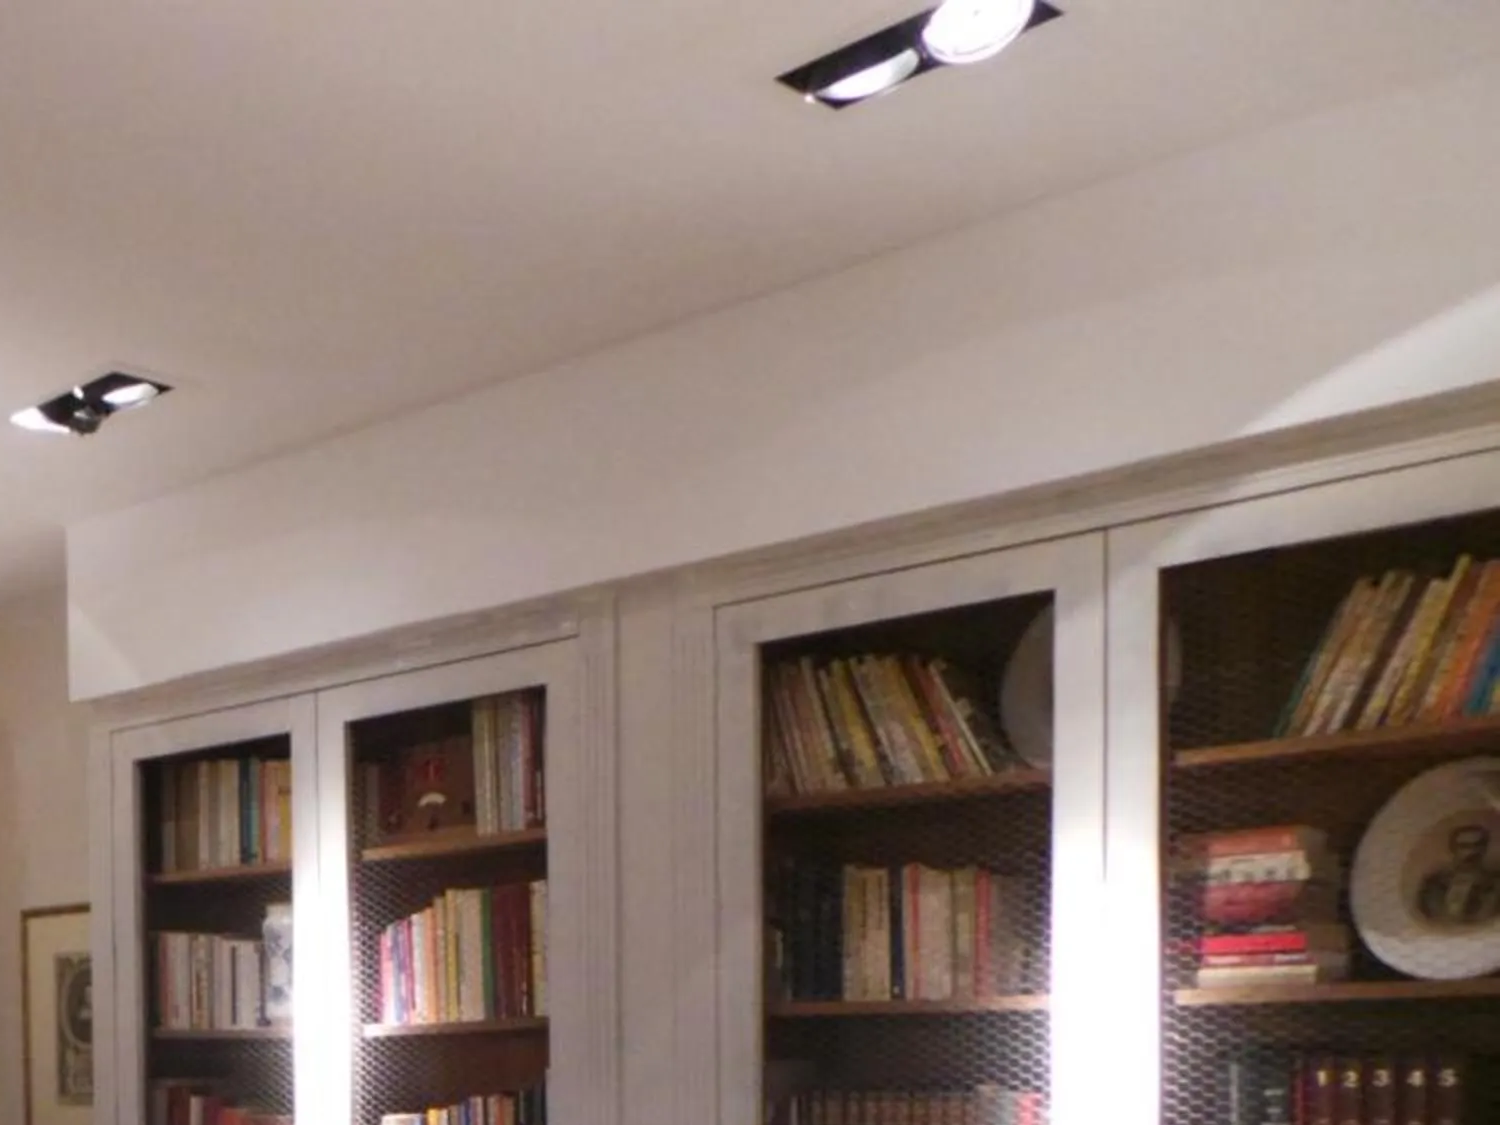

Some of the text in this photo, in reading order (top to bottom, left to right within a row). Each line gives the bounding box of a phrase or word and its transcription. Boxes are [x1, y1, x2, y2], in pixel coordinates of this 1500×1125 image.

[1316, 1070, 1327, 1087] 1
[1342, 1070, 1359, 1088] 2
[1372, 1069, 1391, 1087] 3
[1406, 1070, 1424, 1087] 4
[1438, 1068, 1458, 1087] 5
